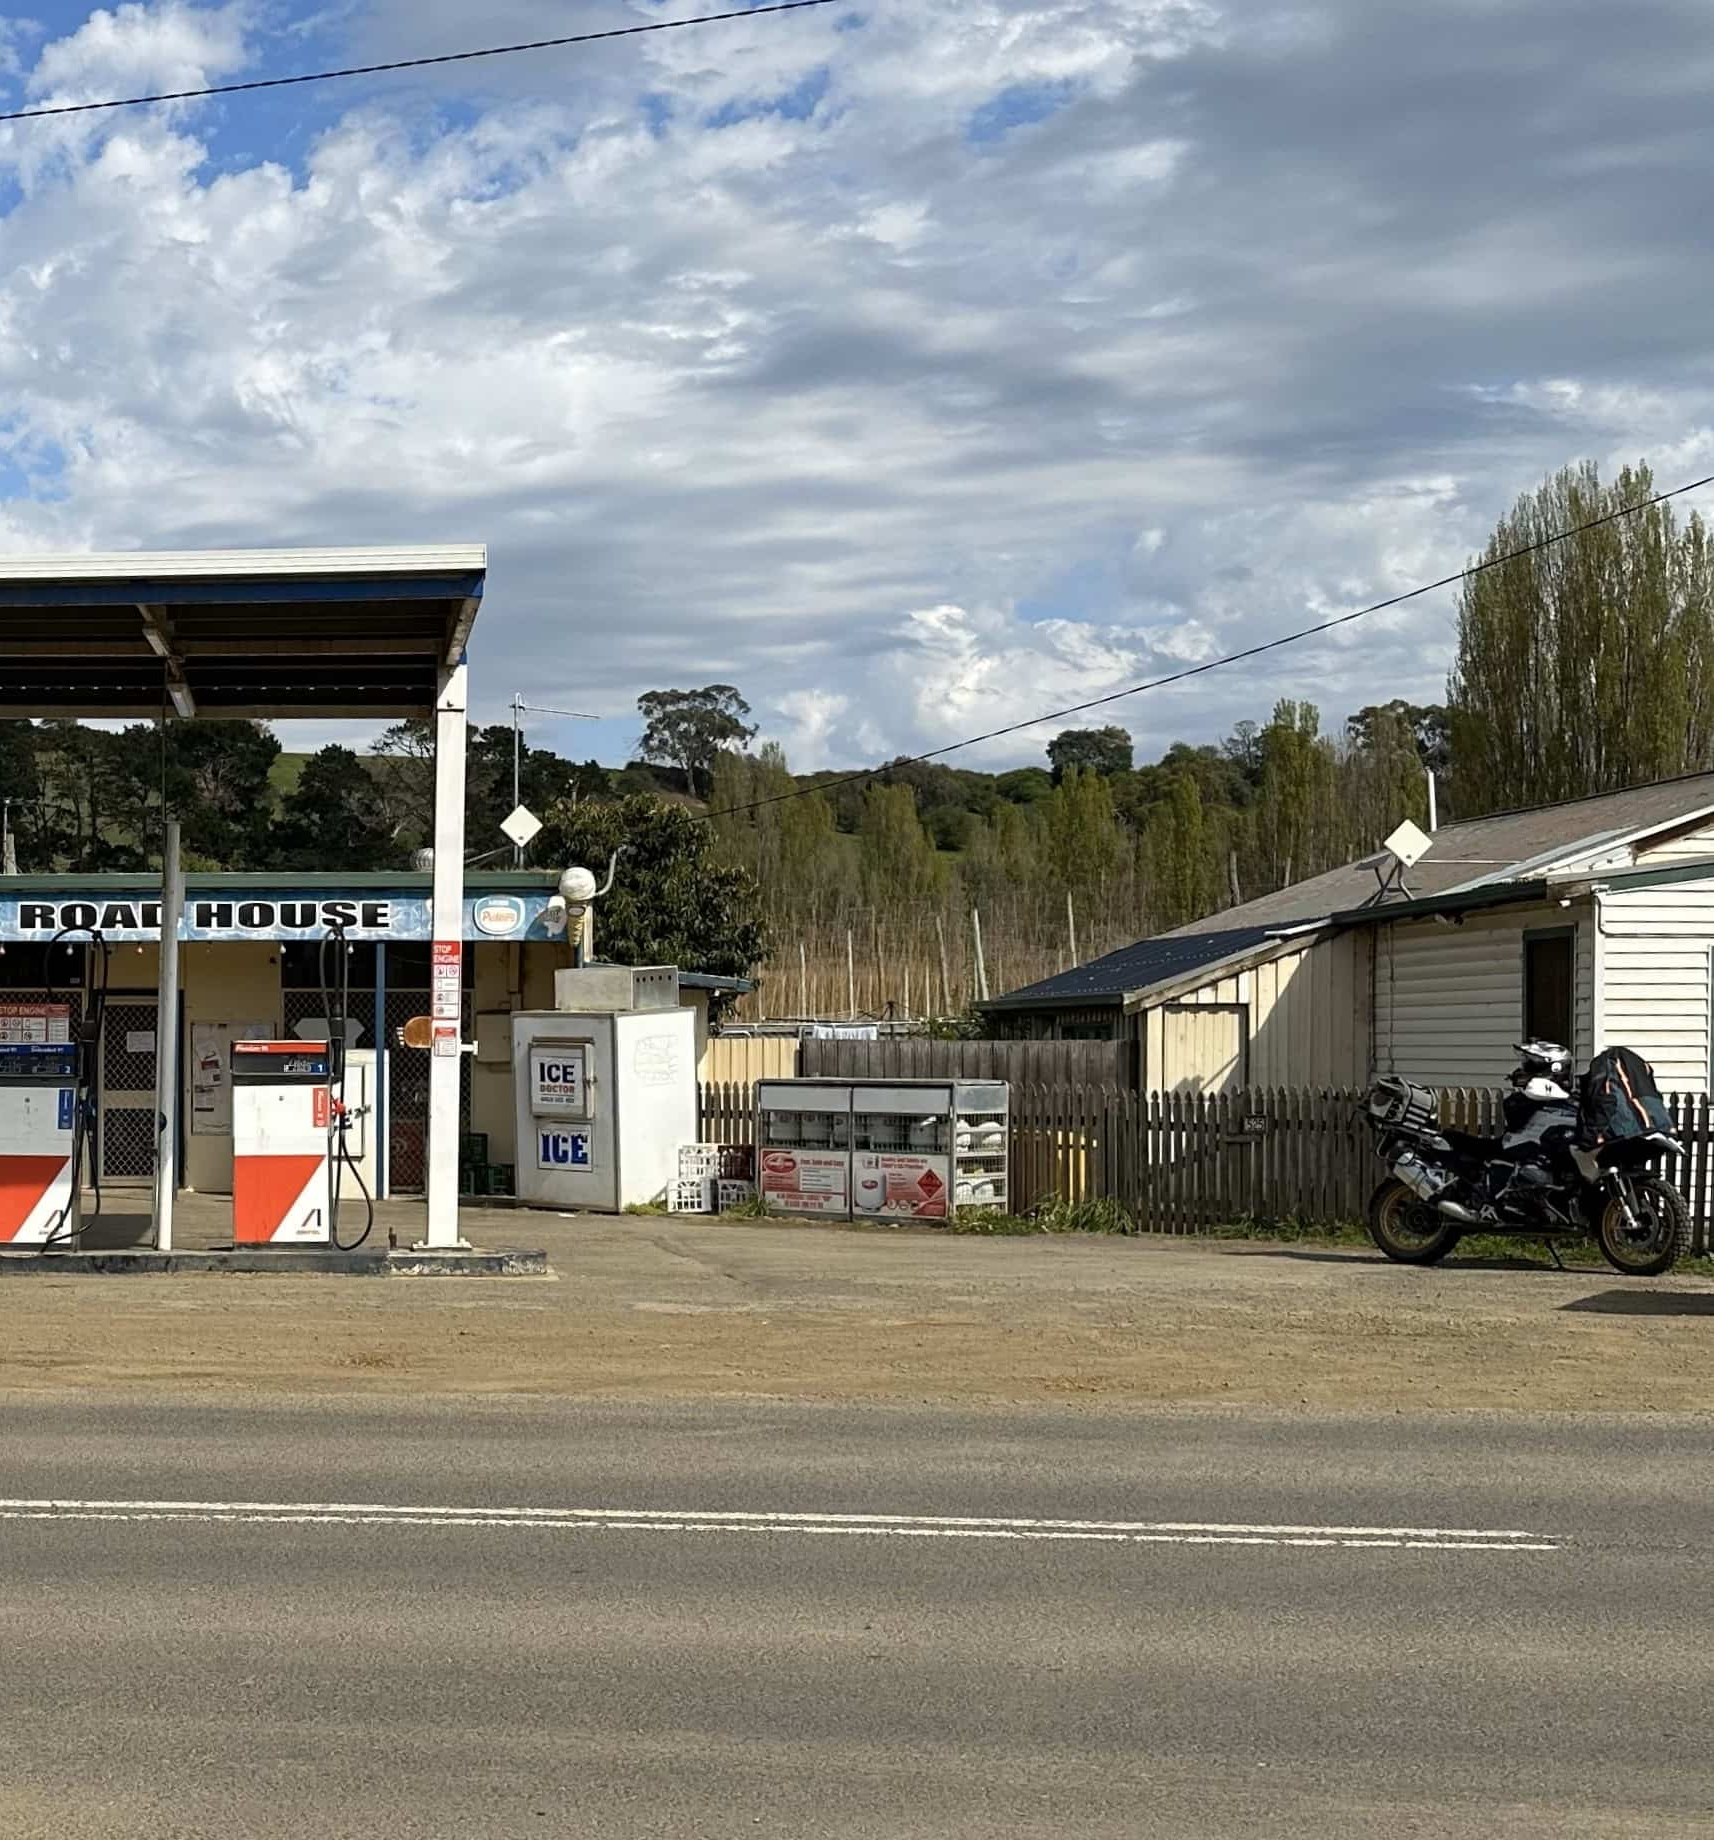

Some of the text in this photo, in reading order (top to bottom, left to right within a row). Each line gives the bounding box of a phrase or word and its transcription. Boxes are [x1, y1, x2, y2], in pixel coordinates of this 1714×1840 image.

[196, 902, 390, 928] HOUSE
[433, 944, 452, 953] STOP
[433, 954, 460, 964] ENGINE
[19, 1006, 47, 1015] ENGINE
[318, 1064, 323, 1073] 1
[540, 1062, 575, 1083] ICE
[540, 1084, 575, 1093] DOCTOR
[542, 1134, 588, 1164] ICE
